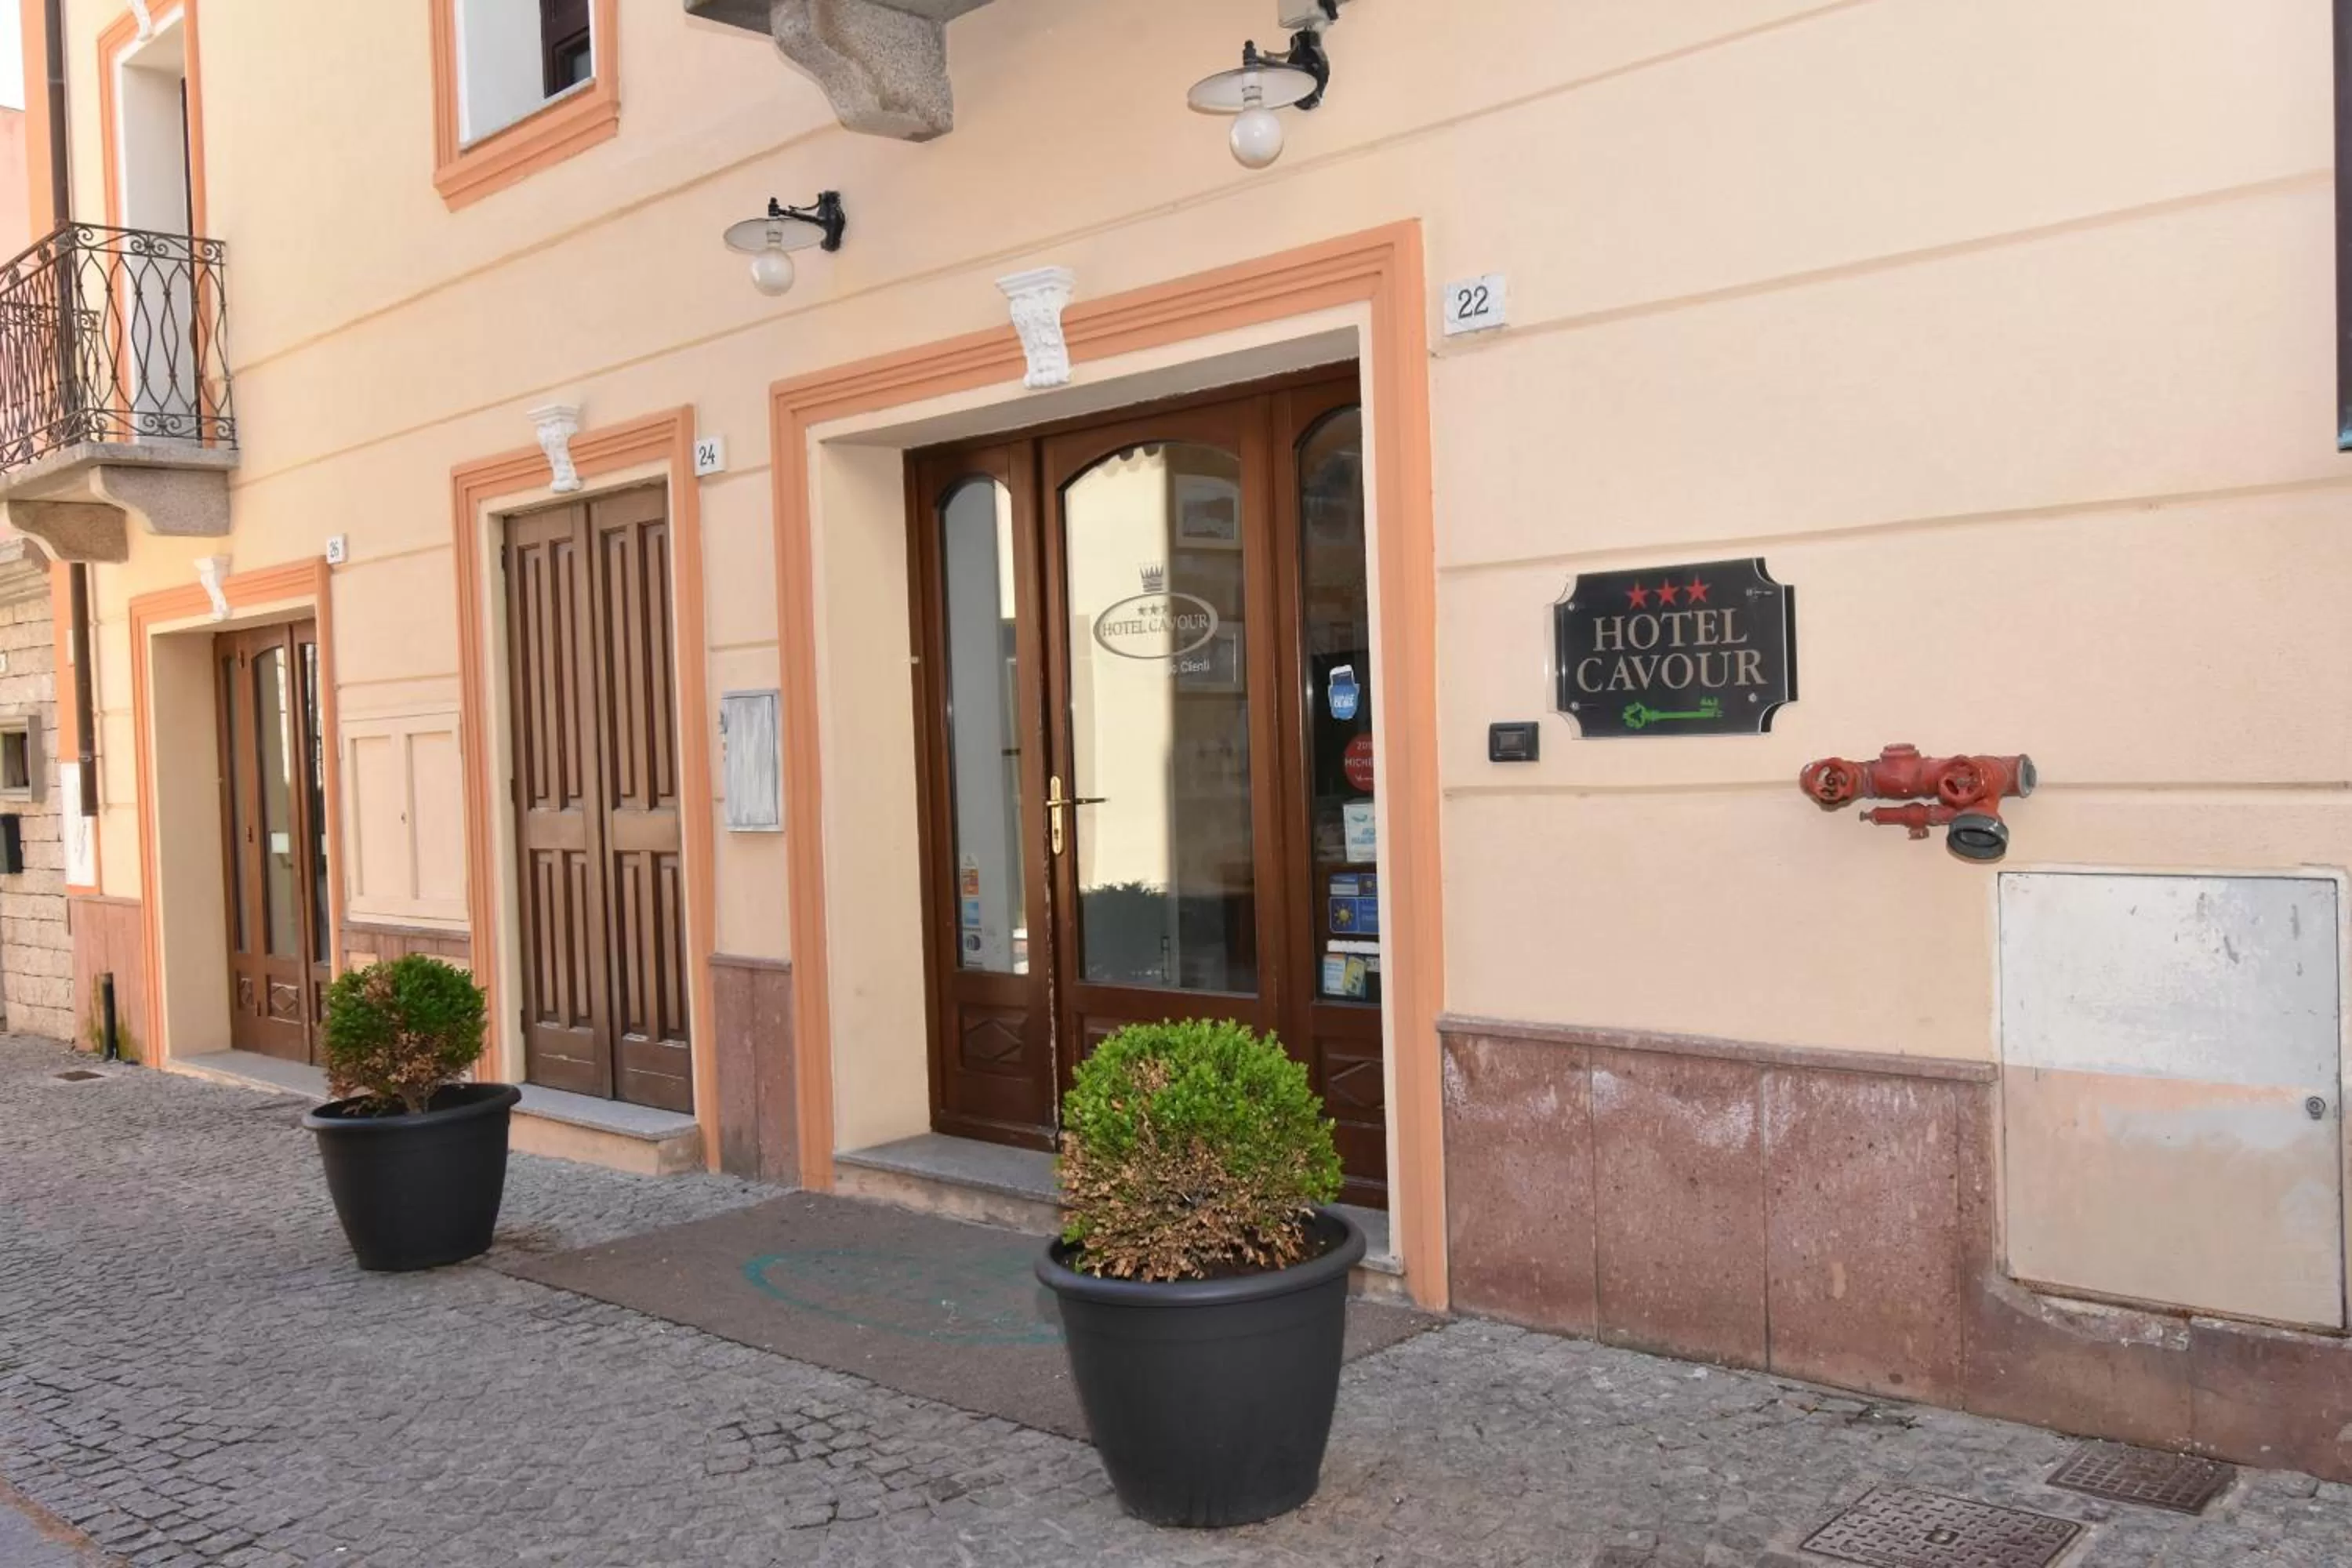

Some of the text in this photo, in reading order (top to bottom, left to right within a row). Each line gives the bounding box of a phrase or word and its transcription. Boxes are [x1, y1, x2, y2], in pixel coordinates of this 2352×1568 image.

[1457, 285, 1489, 319] 22
[699, 445, 715, 466] 24
[1102, 614, 1208, 637] HOTEL CAVOUR
[1592, 608, 1748, 652] HOTEL
[1576, 648, 1768, 692] CAVOUR
